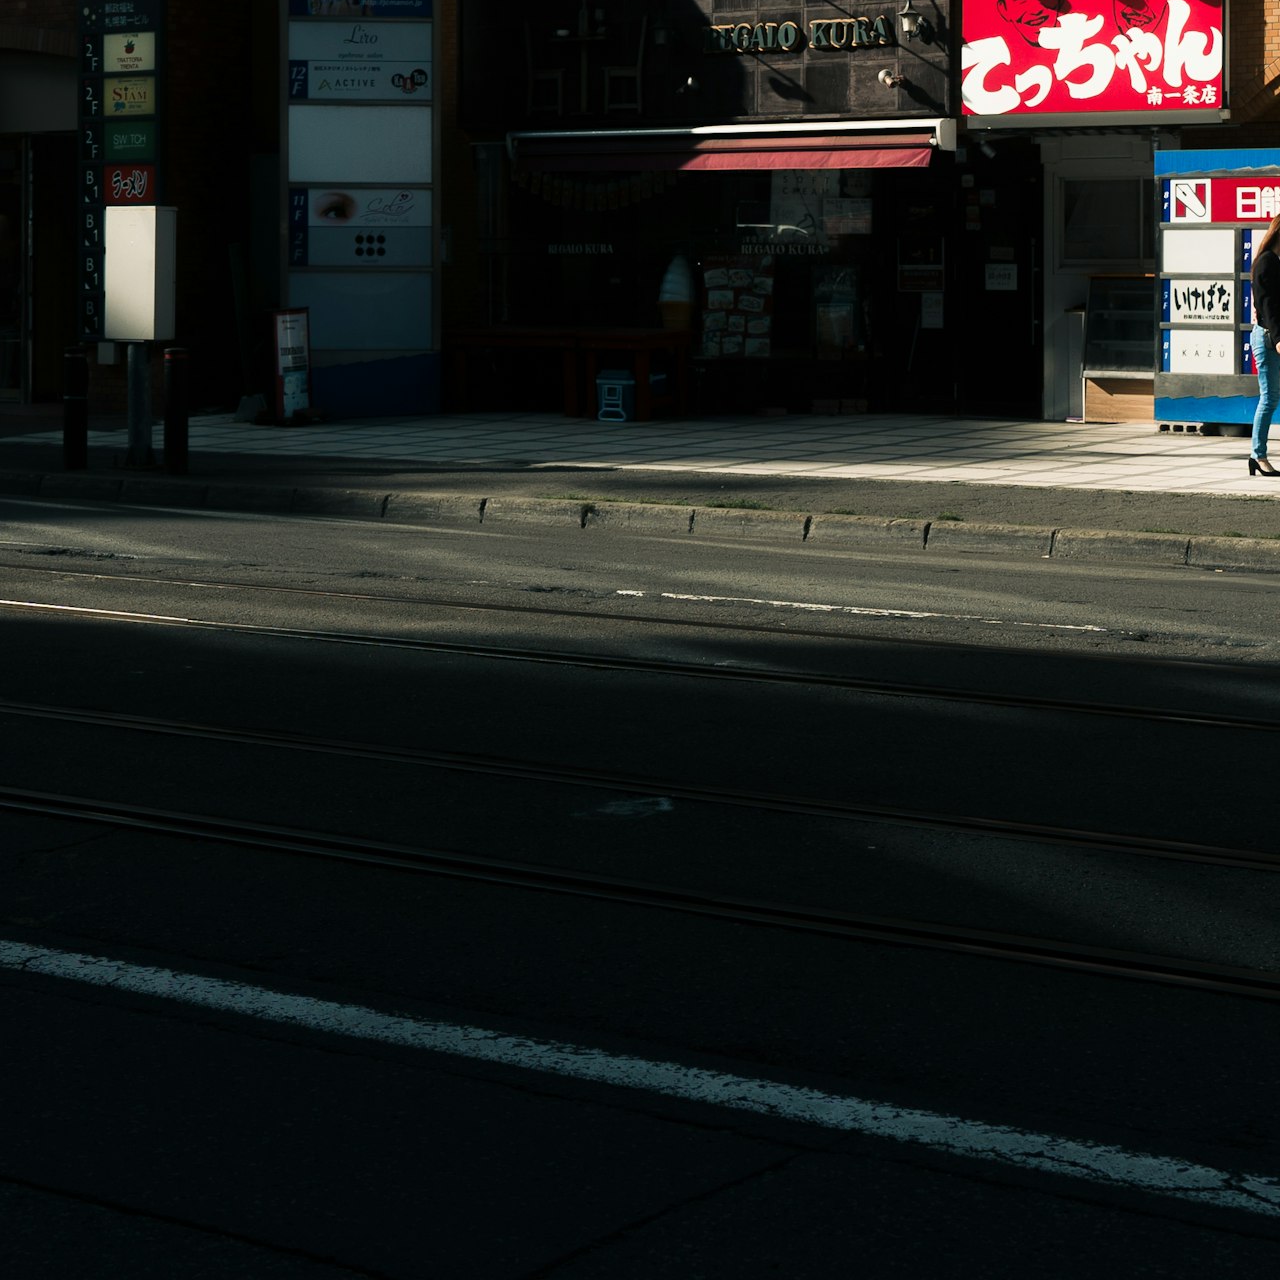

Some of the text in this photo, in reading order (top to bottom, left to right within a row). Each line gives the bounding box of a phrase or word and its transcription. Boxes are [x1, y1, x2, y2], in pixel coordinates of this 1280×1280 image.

[705, 14, 894, 55] REGALO KURA
[334, 78, 376, 88] ACTIVE
[1147, 85, 1217, 106] 南一条店
[111, 170, 148, 198] ラーメン
[585, 243, 614, 254] KURA
[740, 244, 825, 255] REGALO KURA
[1173, 281, 1231, 312] いけばな
[1181, 349, 1225, 359] KAZU
